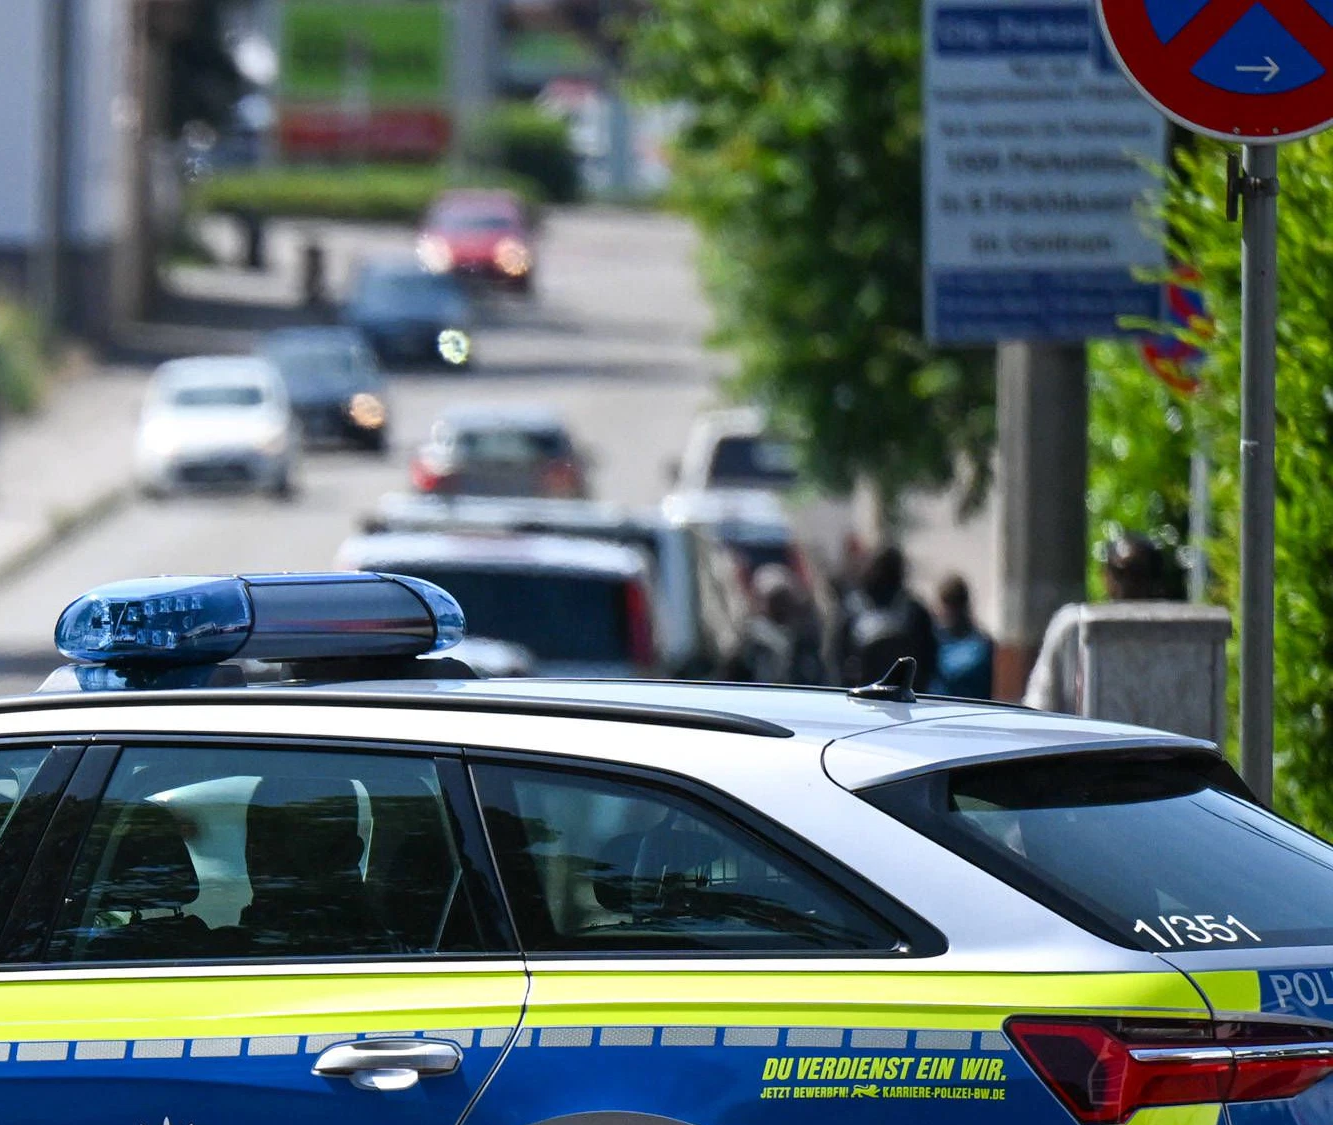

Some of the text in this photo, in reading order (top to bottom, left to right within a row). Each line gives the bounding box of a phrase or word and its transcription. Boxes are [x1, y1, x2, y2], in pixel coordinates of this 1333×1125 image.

[1133, 914, 1262, 948] 1/351
[1269, 969, 1333, 1008] POL
[761, 1057, 1007, 1082] DU VERDIENST EIN WIR.
[760, 1086, 792, 1099] JETZT
[882, 1086, 1006, 1100] KARRIERE-POLIZEI-BW.DE
